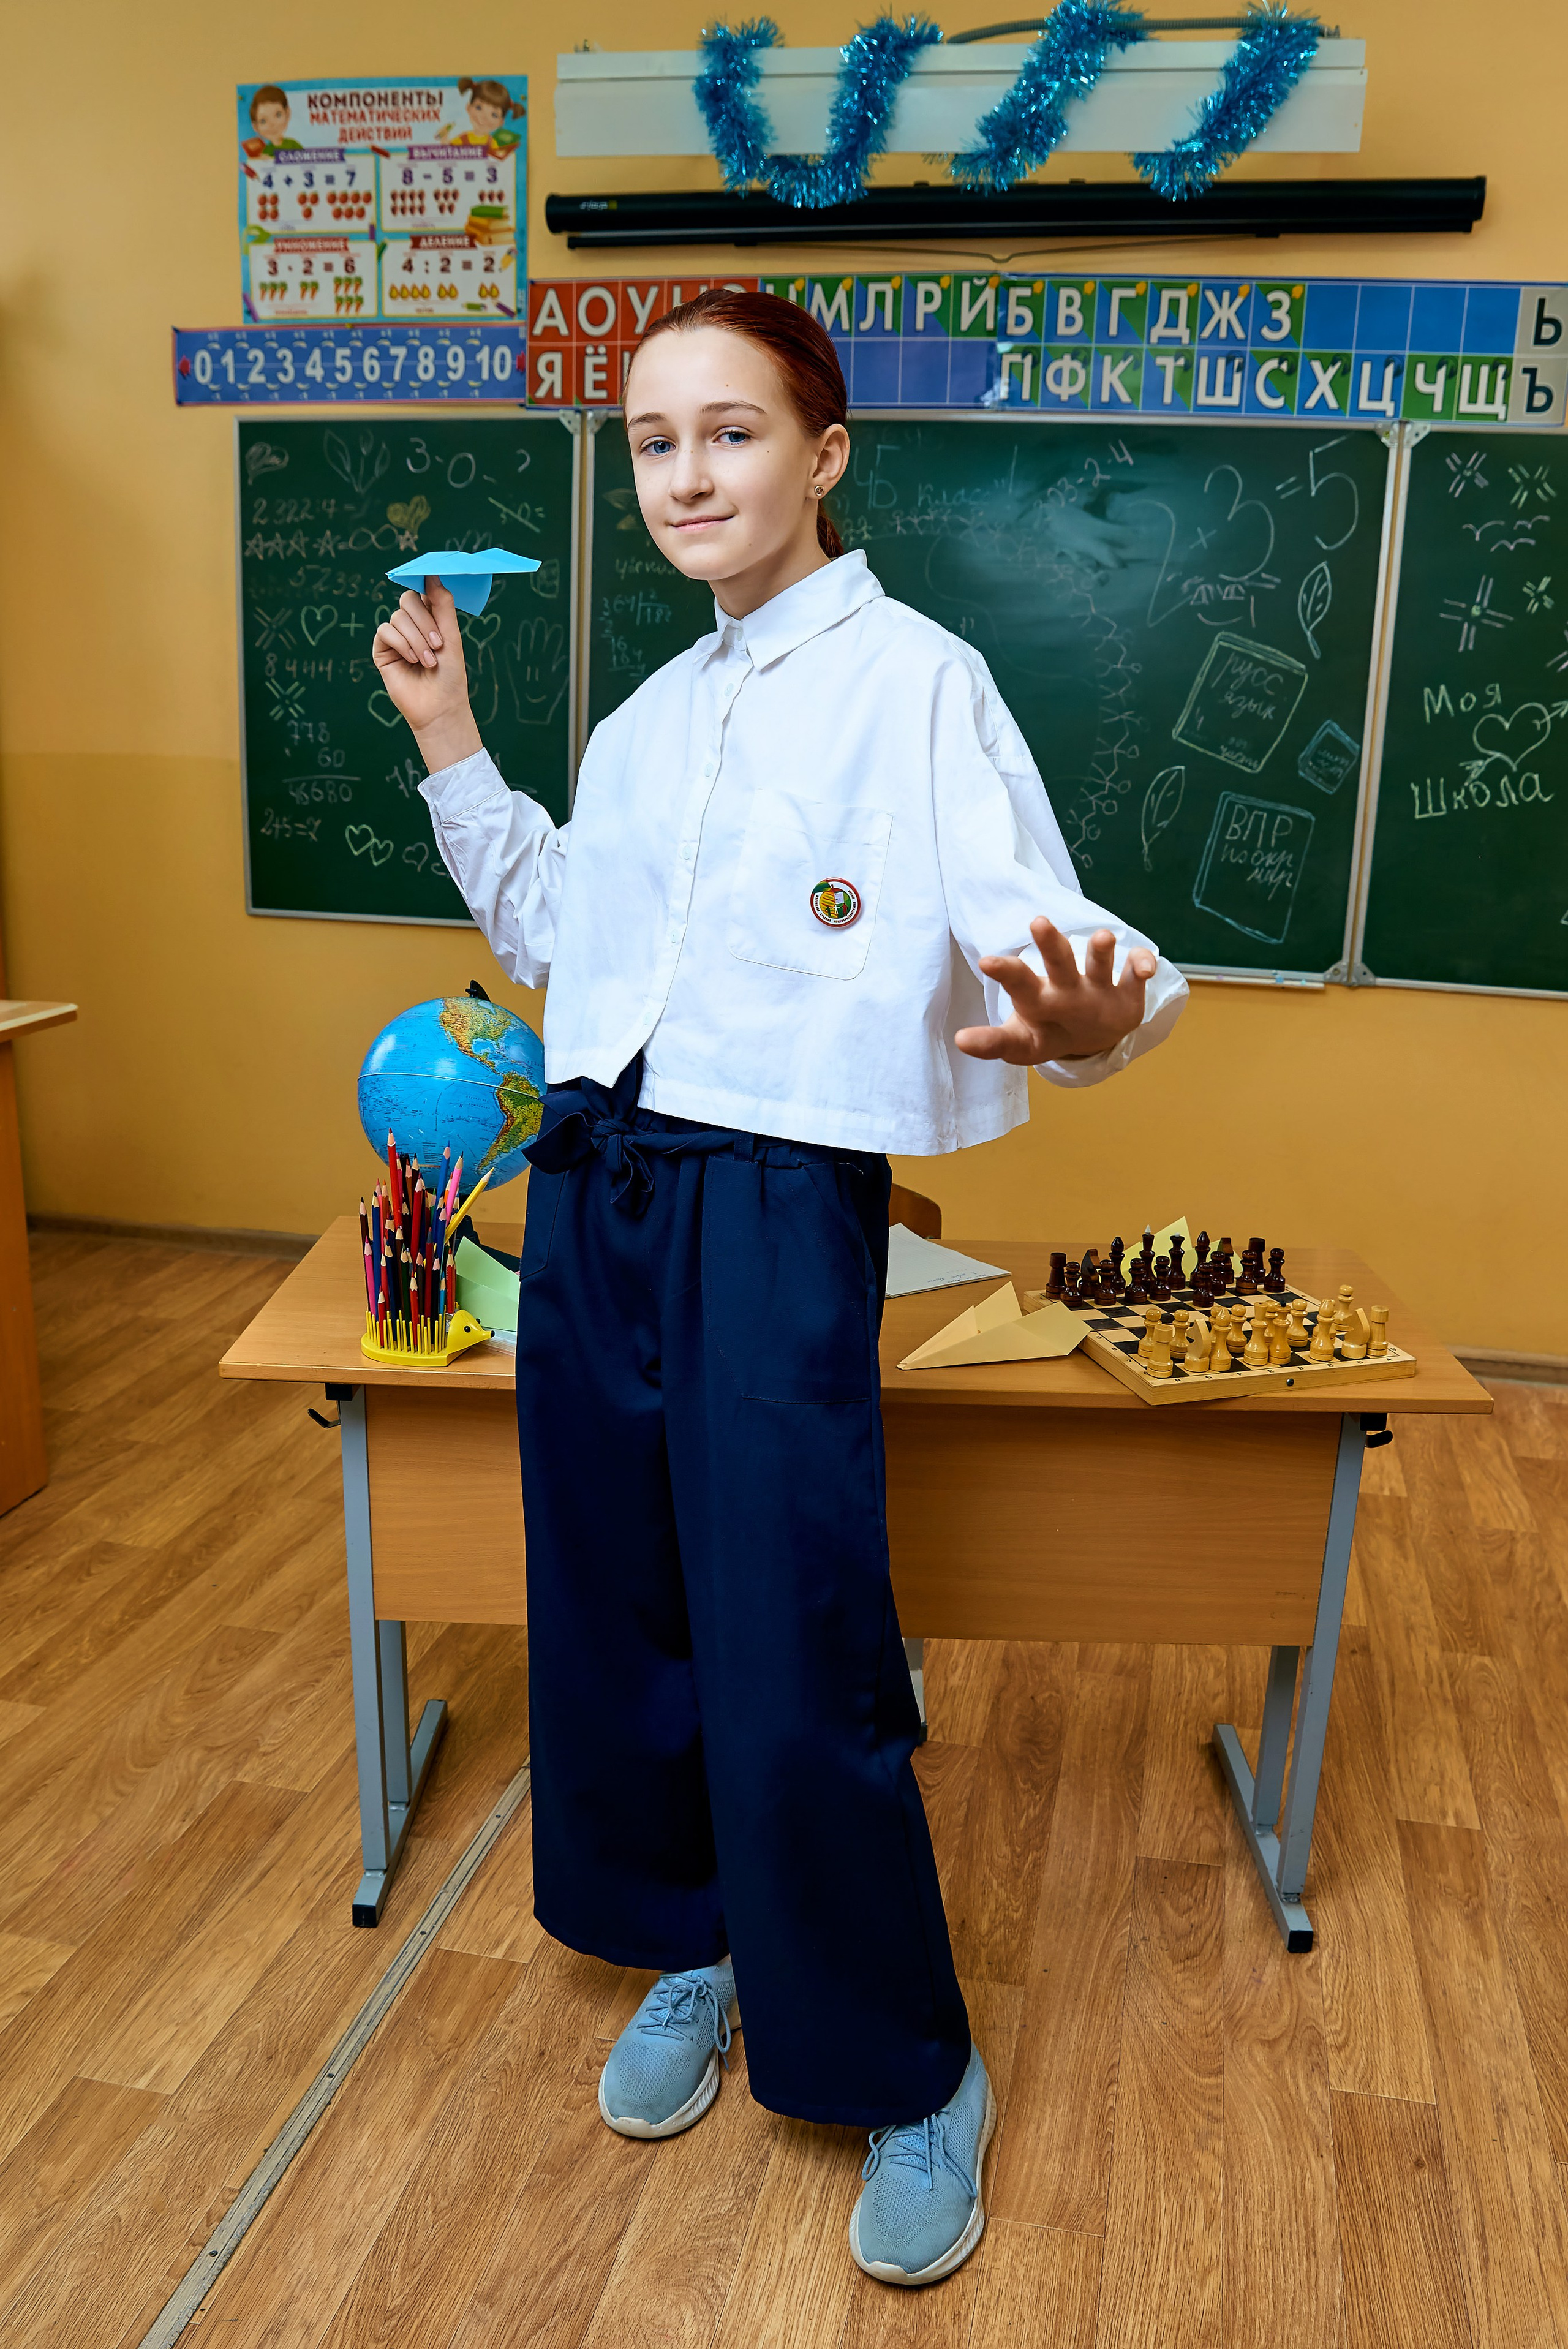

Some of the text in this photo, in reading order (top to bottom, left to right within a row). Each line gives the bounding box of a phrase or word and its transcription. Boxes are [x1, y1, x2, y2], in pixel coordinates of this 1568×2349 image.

[308, 91, 443, 108] КОМПОНЕНТЫ
[310, 109, 441, 125] МАТЕМАТИЧЕСКИХ
[338, 126, 412, 143] ДЕЙСТВИЙ
[279, 151, 341, 163] СЛОЖЕНИЕ
[413, 148, 483, 158] ВЫЧИТАНИЕ
[263, 174, 273, 189] 4
[303, 171, 314, 187] 3
[345, 170, 356, 187] 7
[402, 168, 413, 185] 8
[443, 168, 453, 185] 5
[487, 167, 497, 183] 3
[420, 237, 470, 247] ДЕЛЕНИЕ
[268, 259, 278, 275] 3
[303, 258, 313, 274] 2
[344, 257, 355, 273] 6
[402, 258, 413, 274] 4
[440, 258, 451, 273] 2
[484, 257, 494, 273] 2
[532, 288, 570, 336] А
[577, 286, 617, 337] О
[859, 282, 894, 331] Л
[915, 281, 942, 331] Р
[960, 277, 997, 332] Й
[1006, 287, 1033, 336] Б
[1056, 287, 1084, 336] В
[1108, 287, 1138, 337] Г
[1150, 288, 1190, 345] Д
[1200, 289, 1247, 340] Ж
[1260, 290, 1291, 341] З
[1533, 298, 1562, 345] Ь
[194, 344, 512, 385] 0 1 2 3 4 5 6 7 8 9 10
[534, 351, 562, 399] Я
[584, 344, 608, 399] Ё
[1000, 353, 1032, 400] П
[1045, 353, 1086, 402] Ф
[1101, 354, 1134, 404] К
[1155, 356, 1185, 405] Т
[1196, 356, 1243, 406] Ш
[1254, 358, 1288, 409] С
[1303, 360, 1341, 409] Х
[1358, 361, 1395, 417] Ц
[1415, 362, 1446, 413] Ч
[1458, 364, 1507, 421] Щ
[1522, 368, 1553, 412] Ъ
[1423, 683, 1501, 724] Моя
[317, 747, 345, 767] 60
[1411, 772, 1555, 820] Школа
[1225, 804, 1294, 848] ВПР
